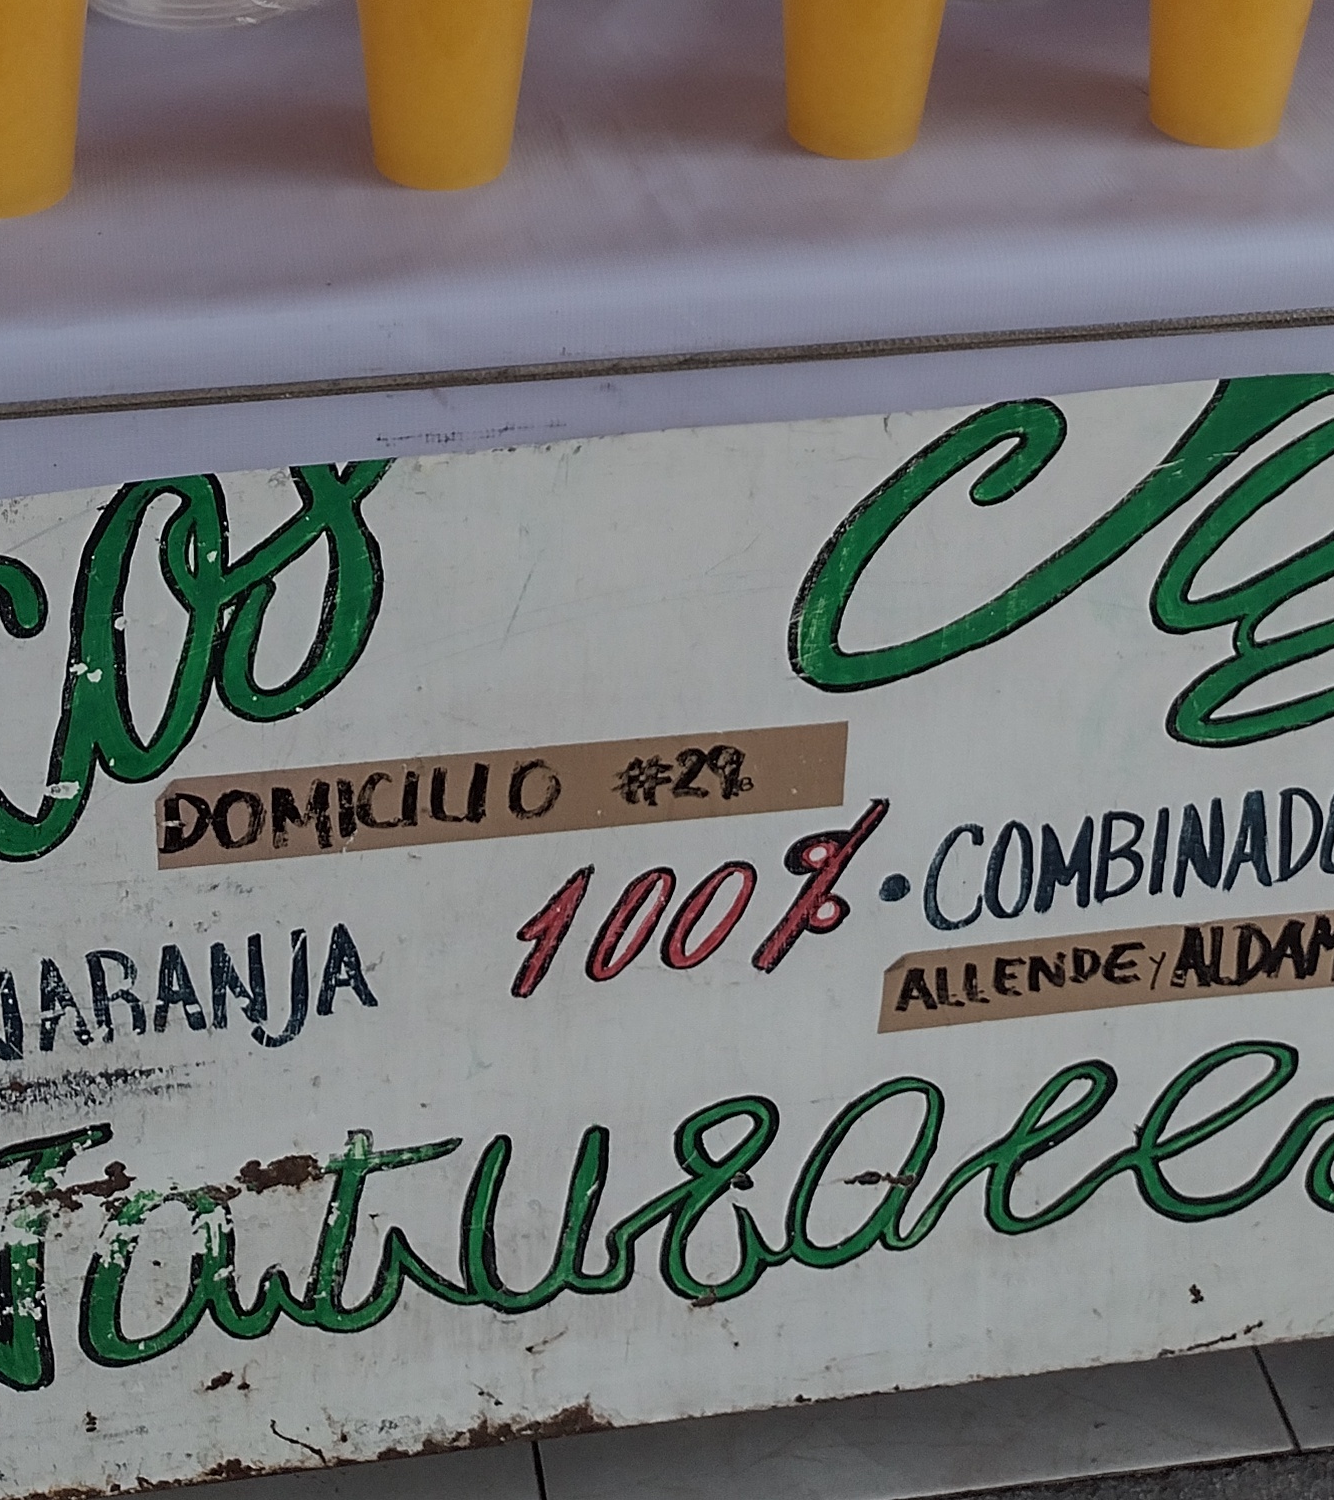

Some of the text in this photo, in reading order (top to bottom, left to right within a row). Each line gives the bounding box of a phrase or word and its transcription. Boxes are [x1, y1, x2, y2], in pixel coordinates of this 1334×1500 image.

[157, 756, 562, 855] DOMICILIO
[509, 797, 890, 1000] 100%
[895, 941, 1147, 1013] ALLENDE
